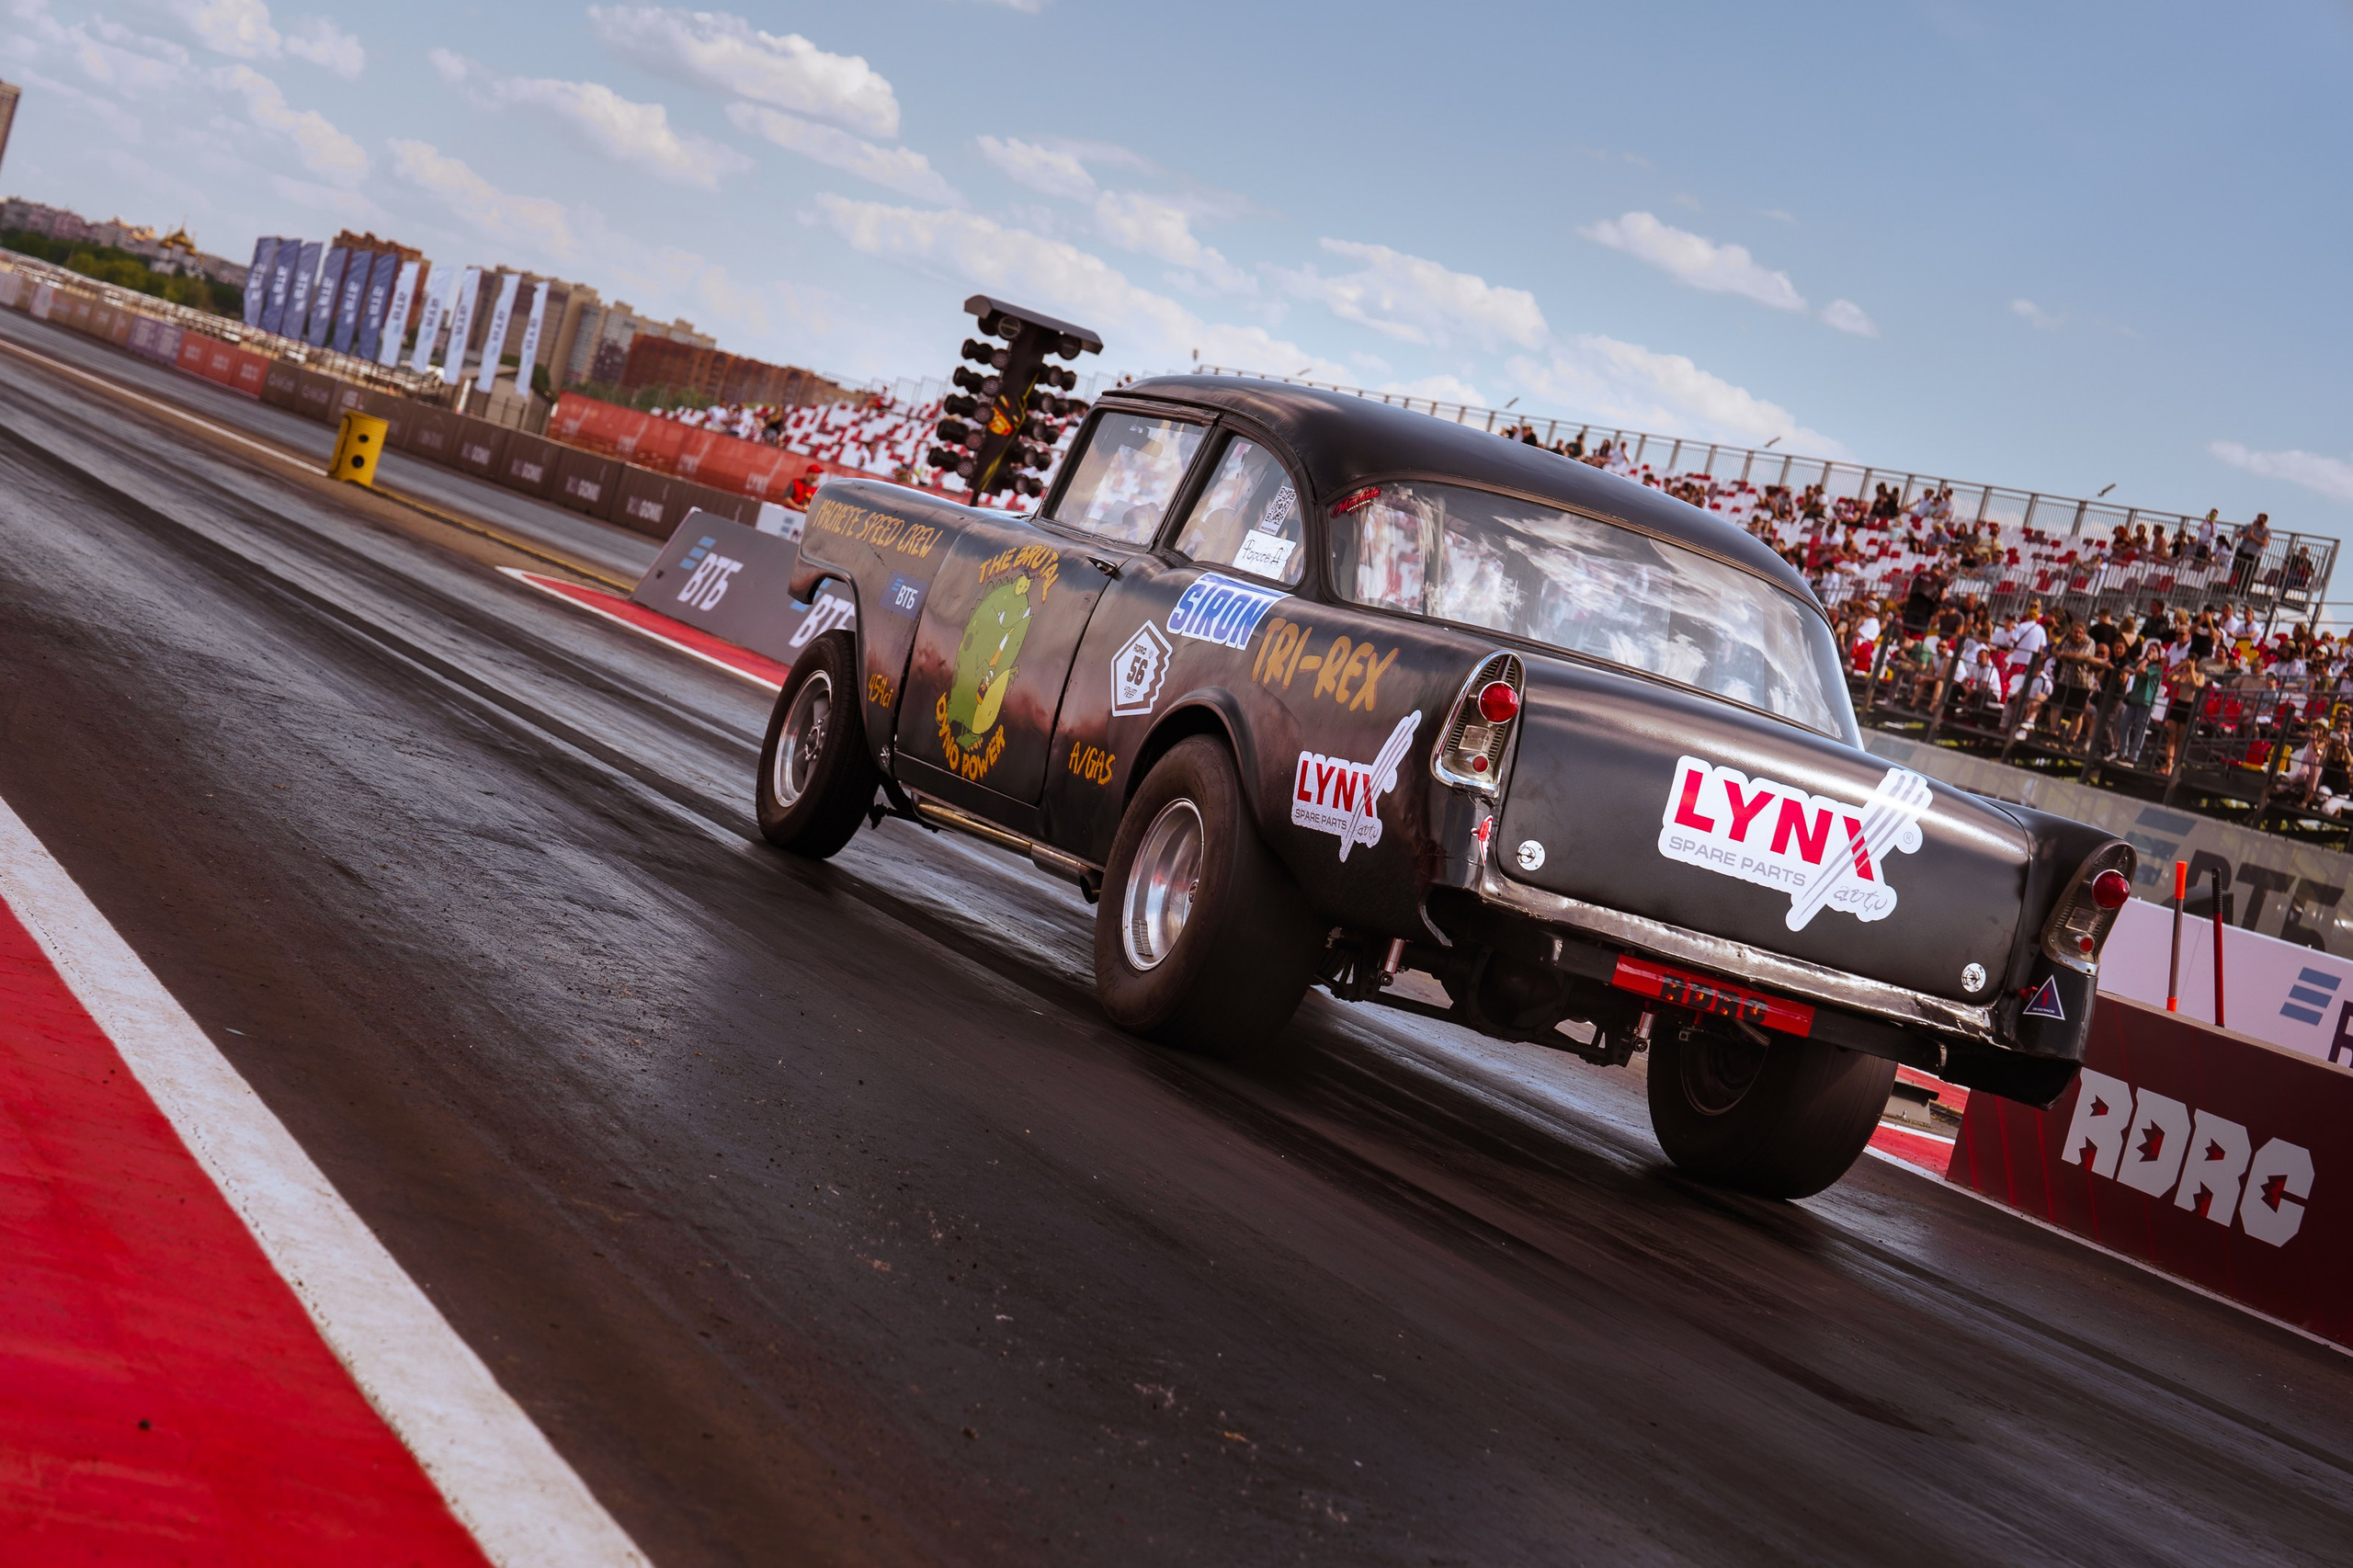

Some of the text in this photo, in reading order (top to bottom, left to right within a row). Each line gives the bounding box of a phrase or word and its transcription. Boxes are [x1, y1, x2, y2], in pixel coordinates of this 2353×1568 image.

[813, 498, 944, 559] MACHETE SPEED CREW
[1330, 486, 1382, 518] Machete
[676, 551, 745, 611] ВТБ
[894, 585, 918, 610] ВТБ
[979, 544, 1059, 605] THE BRUTAL
[1126, 655, 1148, 686] 56
[1252, 617, 1400, 711] TRI-REX
[936, 692, 1006, 780] DYNO POWER
[1068, 741, 1116, 786] A/GAS
[1294, 808, 1347, 830] SPARE PARTS
[1674, 768, 1925, 920] LYNX
[1668, 835, 1807, 887] SPARE PARTS
[1660, 973, 1769, 1024] RDRC
[2062, 1066, 2315, 1248] RDRC
